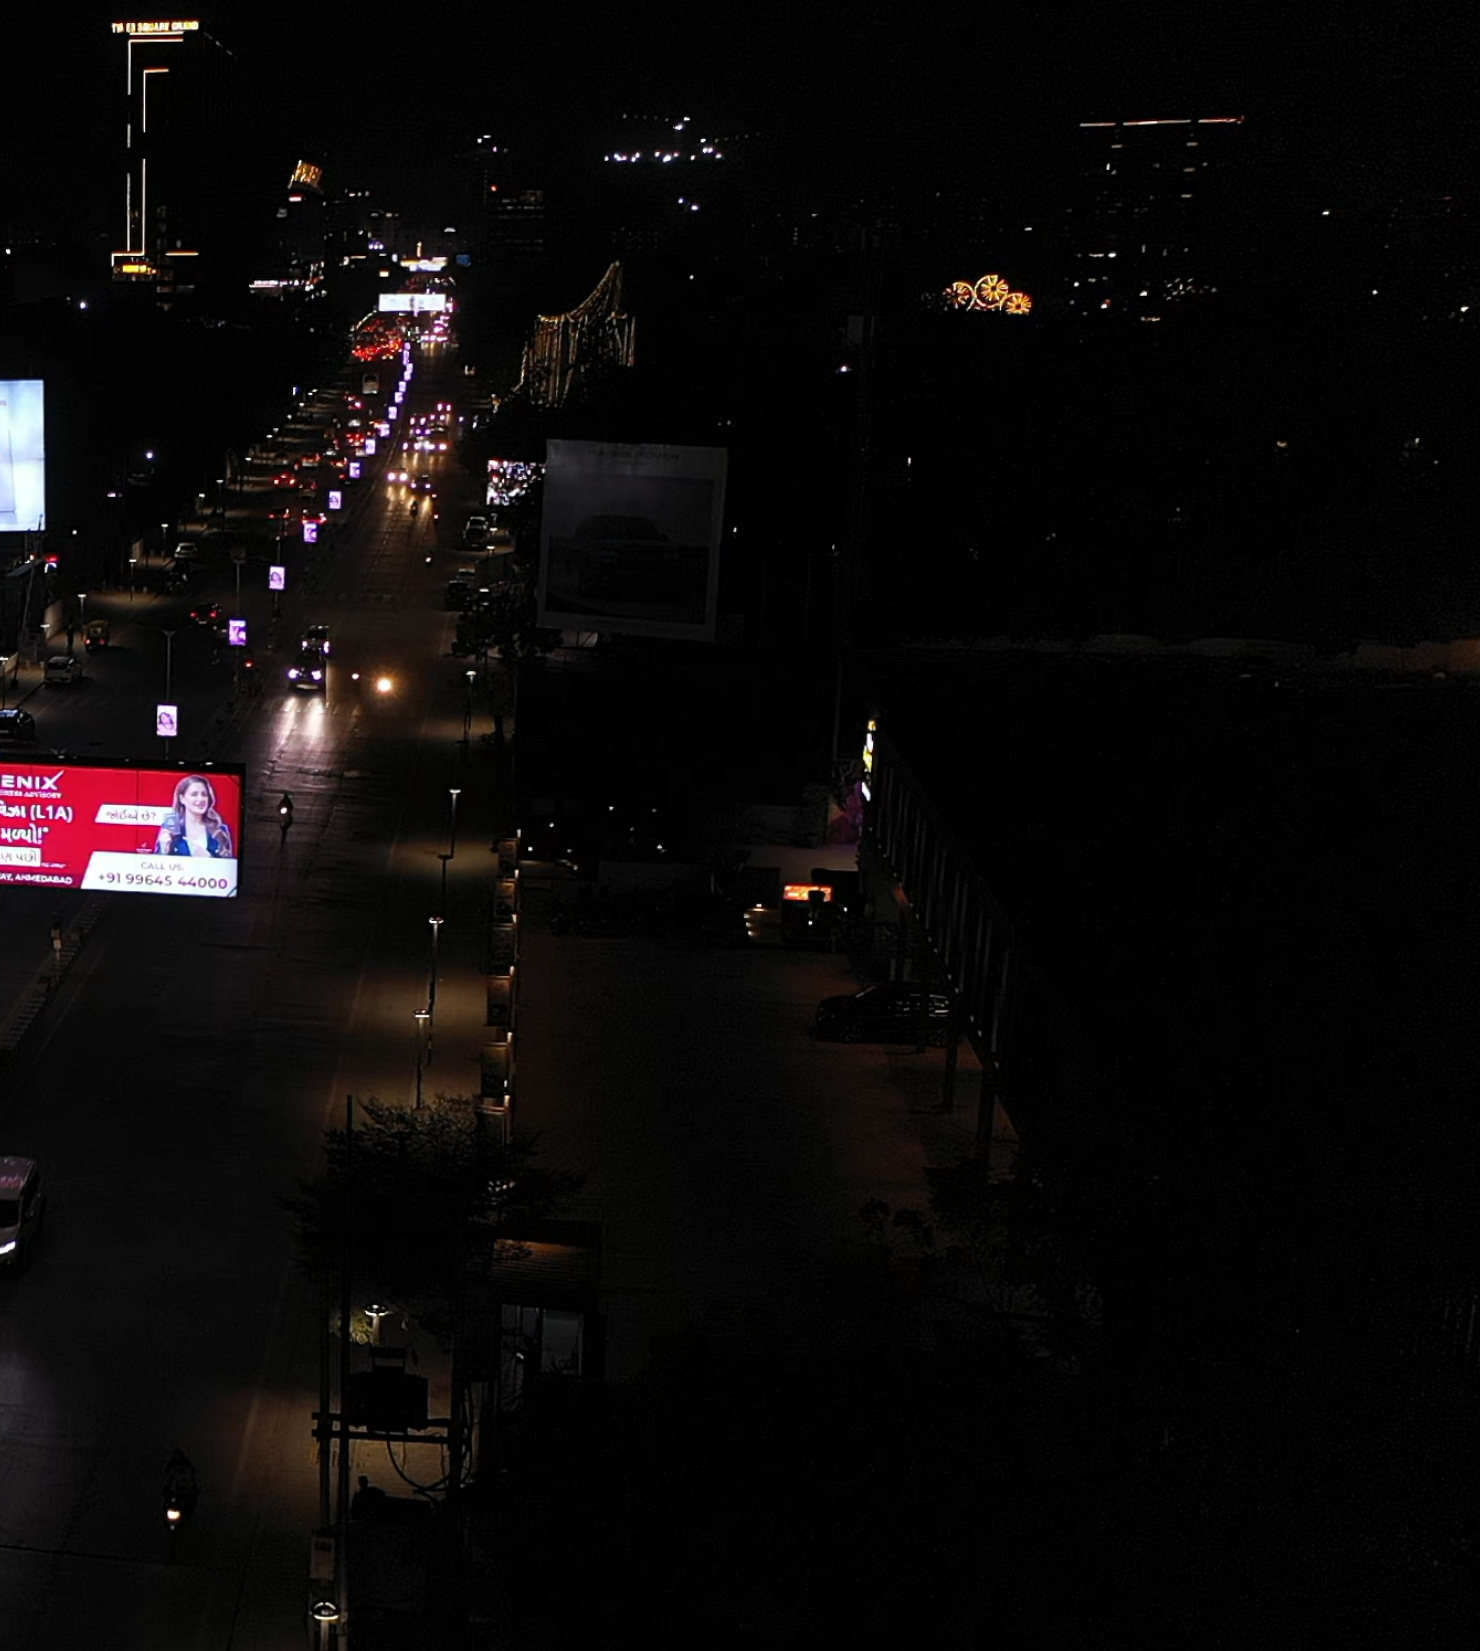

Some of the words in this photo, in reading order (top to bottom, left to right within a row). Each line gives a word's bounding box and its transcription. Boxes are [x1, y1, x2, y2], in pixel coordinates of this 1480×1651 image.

[30, 804, 73, 823] (L1A)
[140, 862, 165, 870] CALL
[15, 873, 73, 884] AHMEDABAD
[99, 872, 121, 884] +91
[125, 873, 172, 887] 99645
[177, 876, 228, 889] 44000
